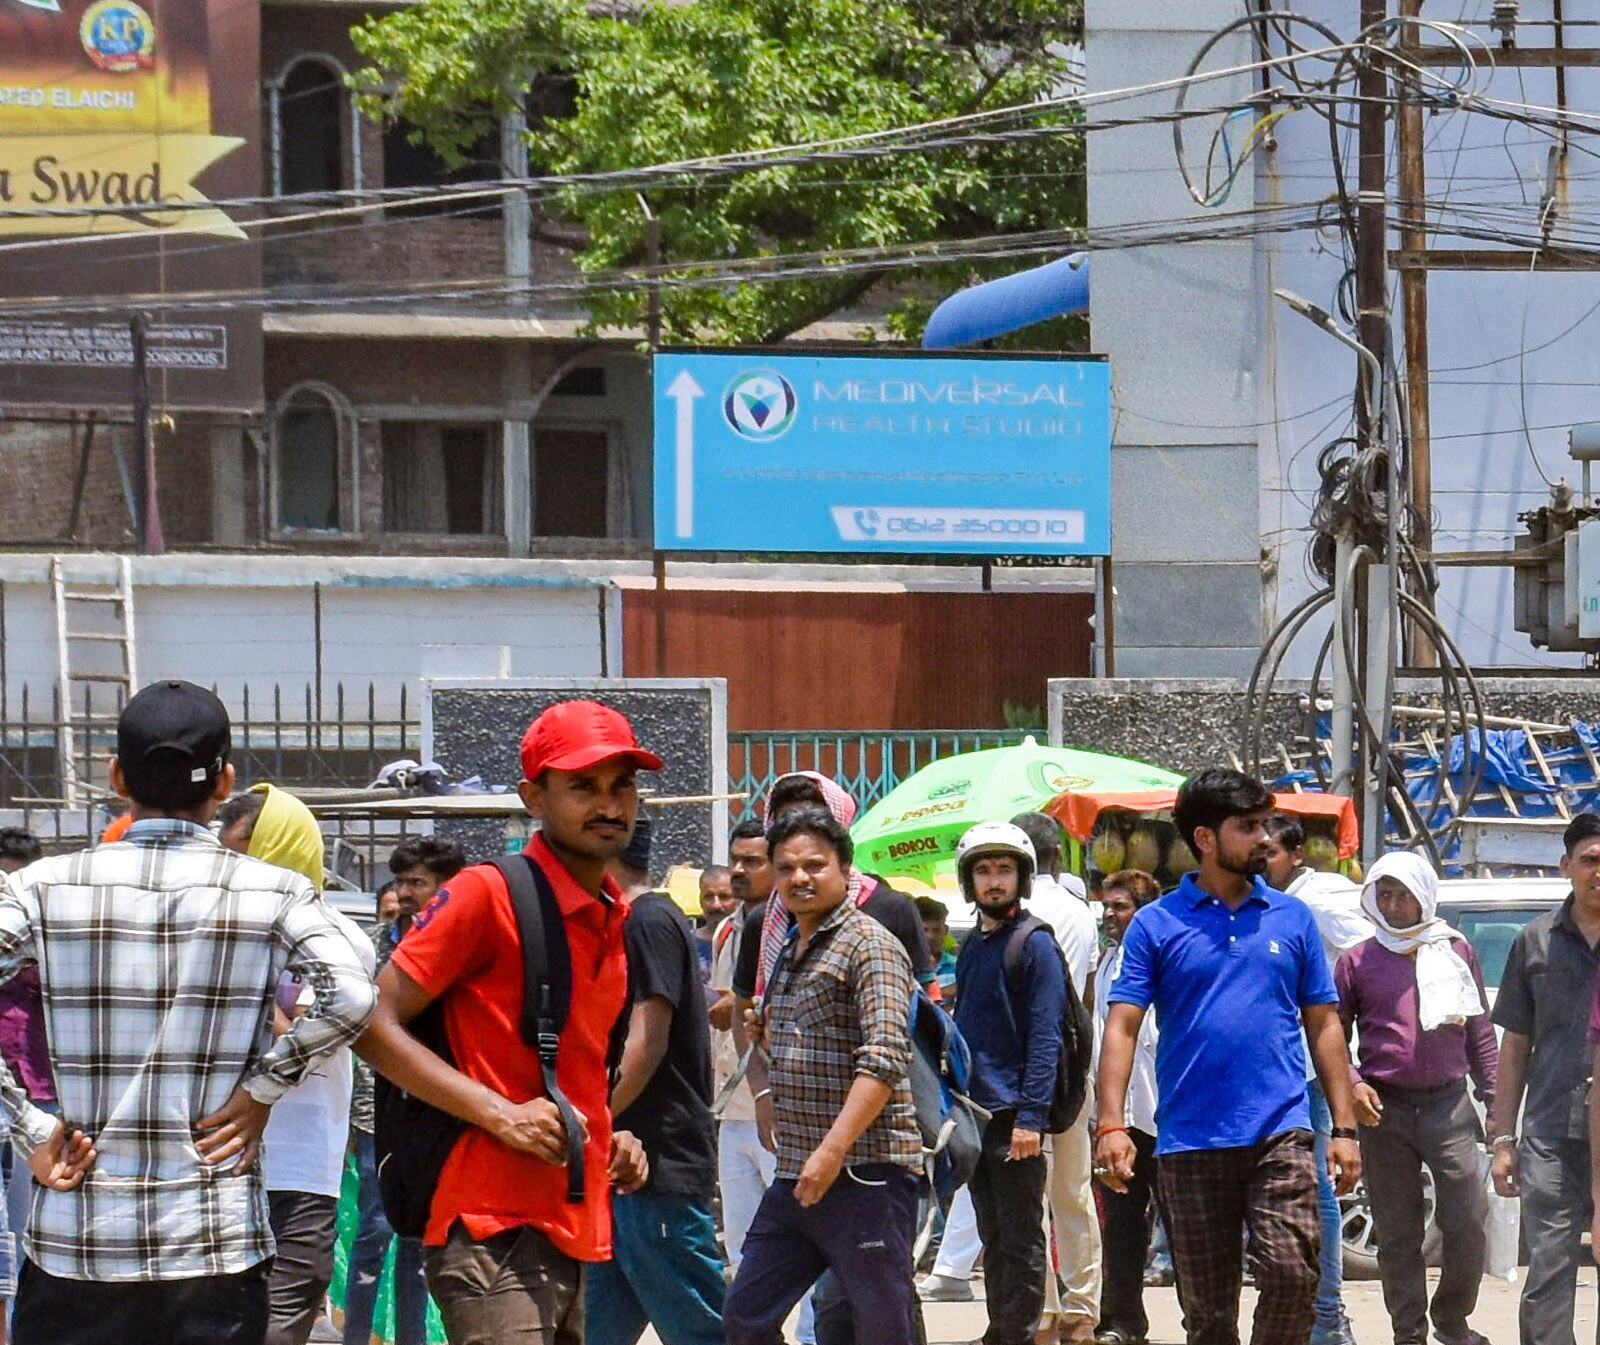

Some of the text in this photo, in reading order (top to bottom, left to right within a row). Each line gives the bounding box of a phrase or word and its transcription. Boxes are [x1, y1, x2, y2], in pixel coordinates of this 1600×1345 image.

[52, 88, 136, 109] ELAICHI
[30, 156, 168, 206] Swad
[813, 377, 1083, 408] MEDIVERSAL
[813, 413, 1082, 437] HEALTH STUDIO
[888, 836, 939, 859] BEDROCK
